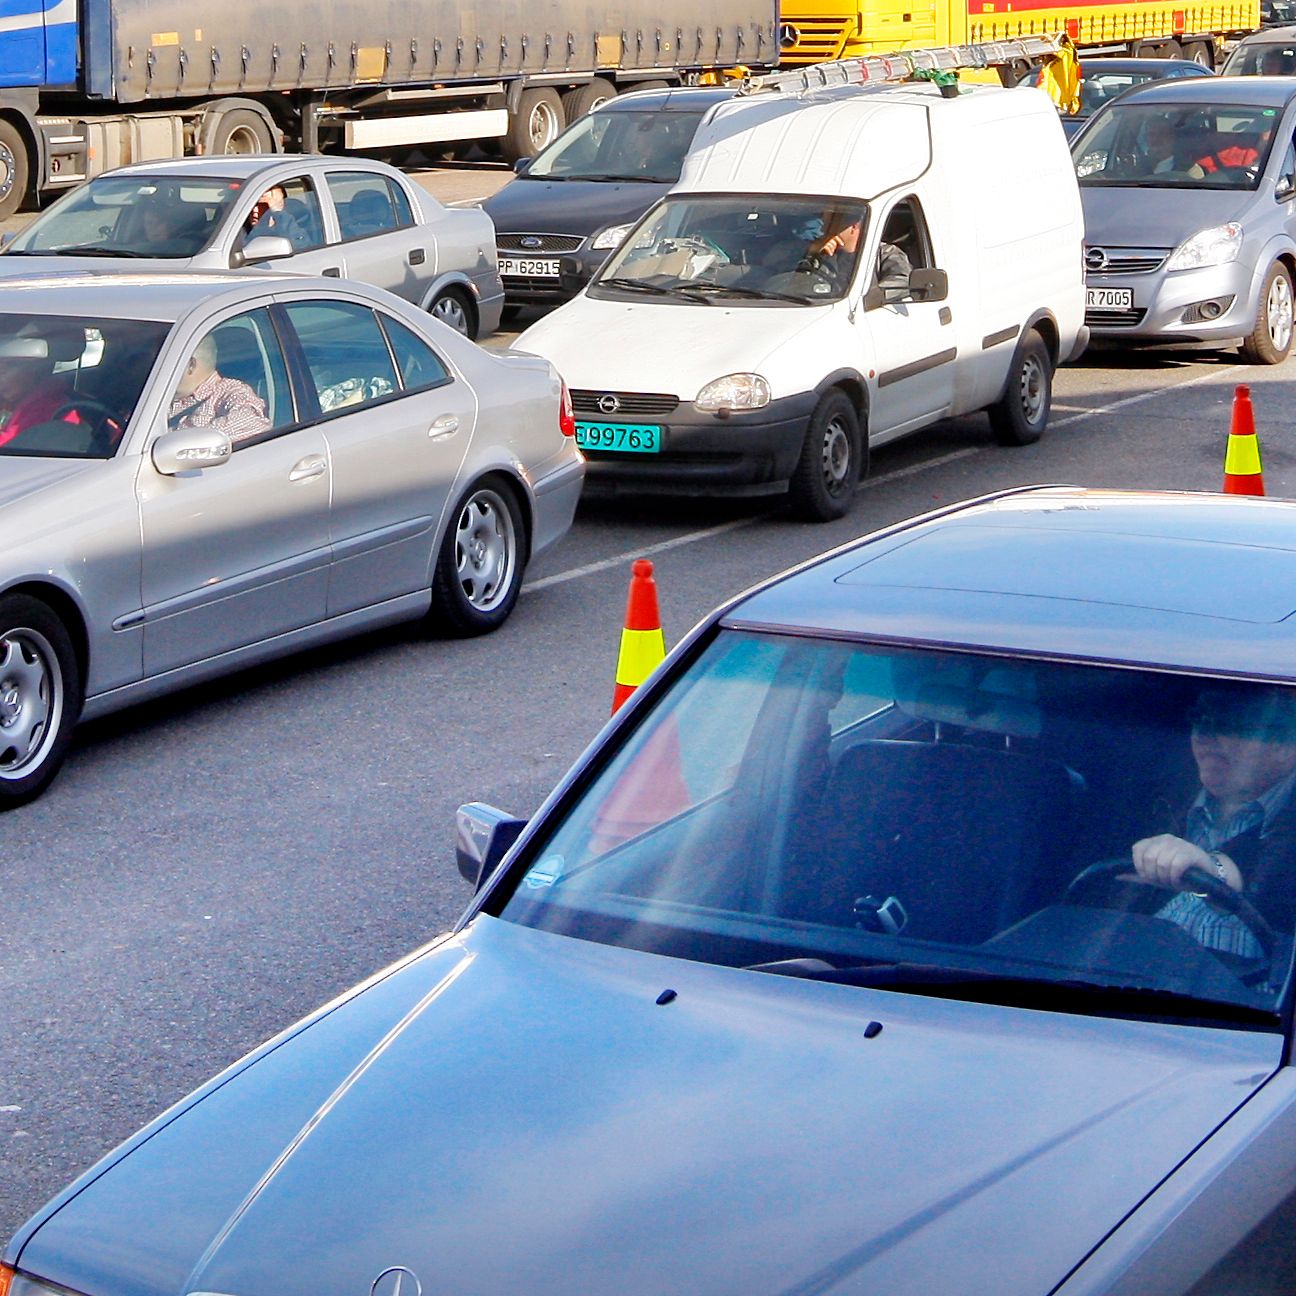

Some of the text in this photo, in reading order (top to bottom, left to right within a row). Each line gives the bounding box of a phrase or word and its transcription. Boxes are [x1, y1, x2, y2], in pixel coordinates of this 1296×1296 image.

[519, 261, 561, 275] 62915
[1099, 291, 1130, 306] 7005
[590, 427, 655, 449] 99763
